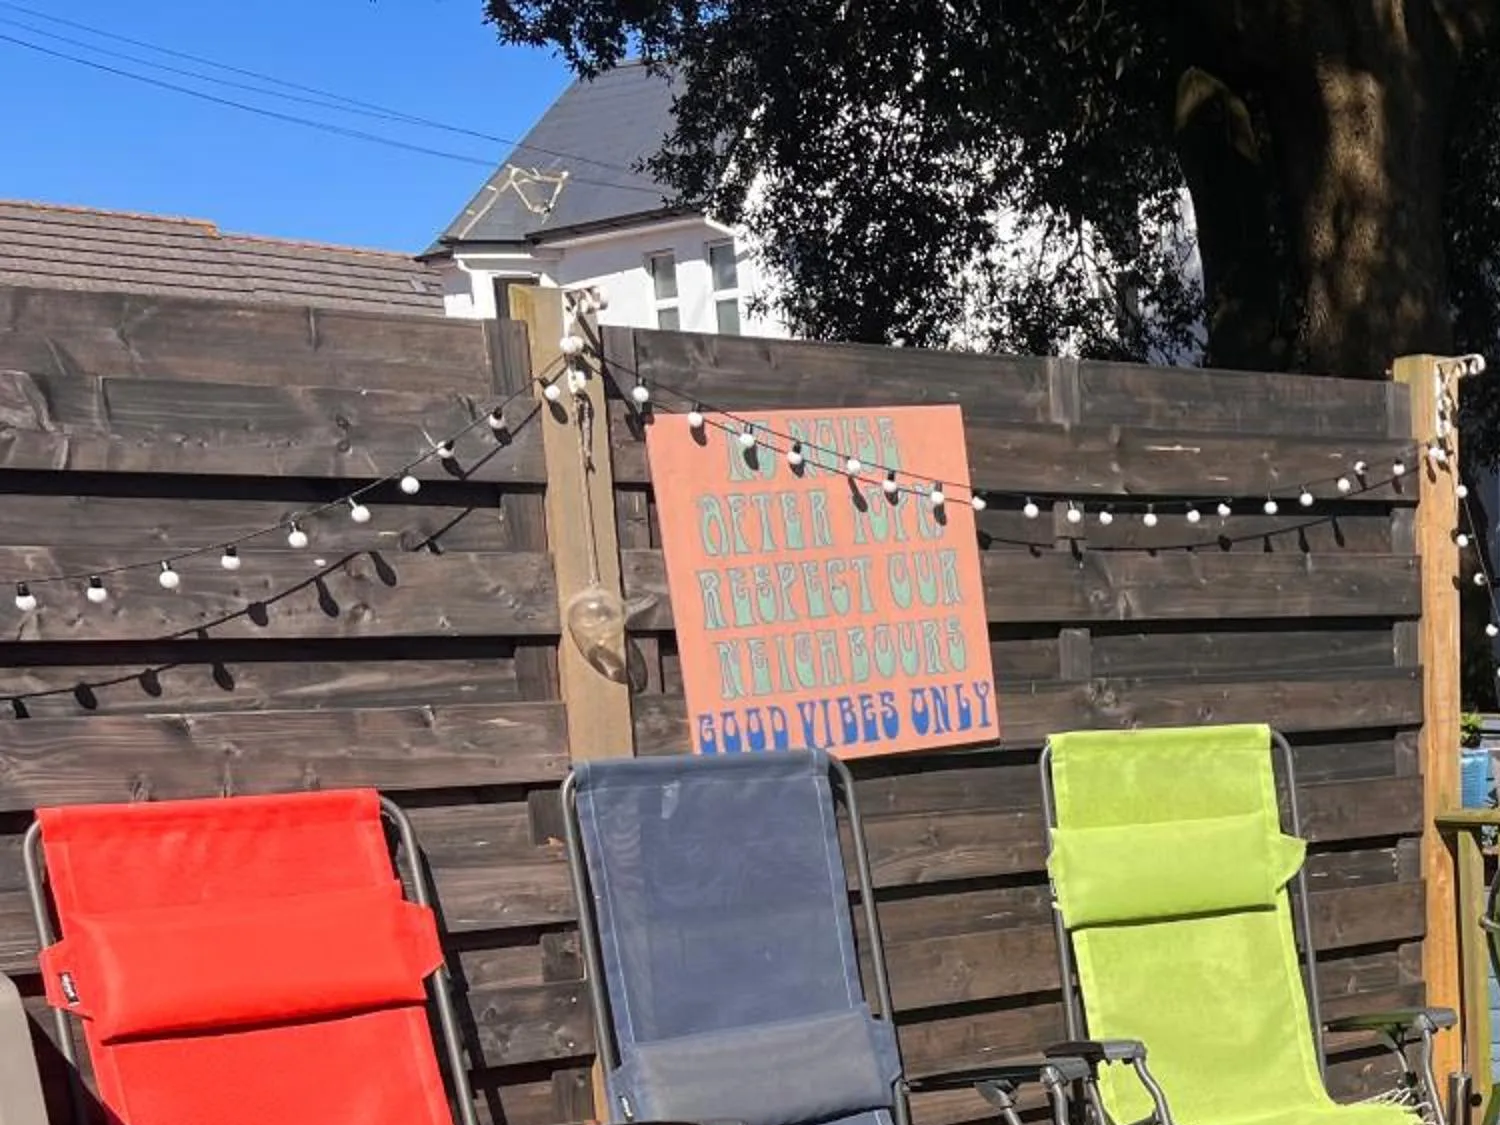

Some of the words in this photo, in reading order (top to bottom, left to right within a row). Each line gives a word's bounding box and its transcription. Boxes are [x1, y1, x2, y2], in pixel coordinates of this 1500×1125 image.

[724, 419, 778, 482] NO
[786, 415, 902, 480] NOISE
[697, 489, 836, 558] AFTER
[695, 556, 877, 630] RESPECT
[886, 548, 963, 610] OUR
[713, 616, 968, 700] NEIGHBOURS
[697, 705, 790, 755] GOOD
[796, 690, 901, 750] VIBES
[910, 681, 993, 737] ONLY
